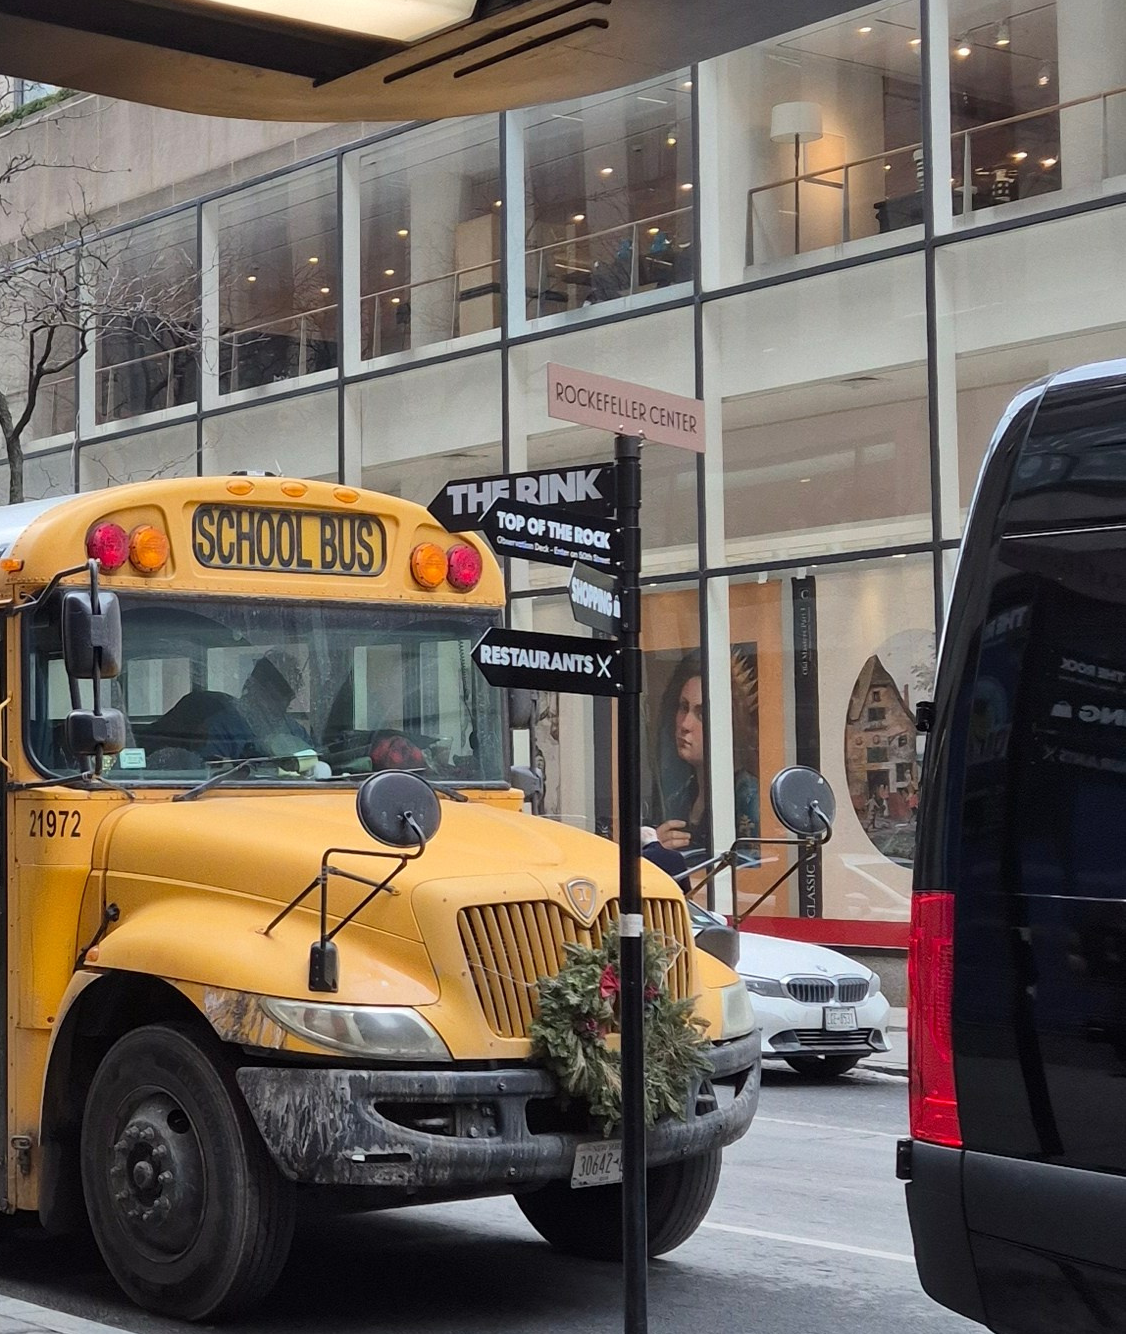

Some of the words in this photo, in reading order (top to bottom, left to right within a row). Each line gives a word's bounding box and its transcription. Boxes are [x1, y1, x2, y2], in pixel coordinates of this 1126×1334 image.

[556, 382, 647, 422] ROCKEFELLER
[649, 405, 698, 435] CENTER
[447, 478, 510, 516] THE
[516, 468, 604, 506] RINK
[197, 508, 313, 569] SCHOOL
[320, 516, 375, 573] BUS
[496, 535, 534, 550] Observation
[534, 542, 550, 553] Deck
[570, 551, 579, 559] on
[497, 510, 526, 533] TOP
[526, 516, 547, 537] OF
[547, 520, 573, 543] THE
[573, 524, 611, 550] ROCK
[571, 576, 613, 617] SHOPPING
[480, 644, 594, 675] RESTAURANTS
[29, 809, 81, 838] 21972
[806, 864, 816, 919] CLASSIC
